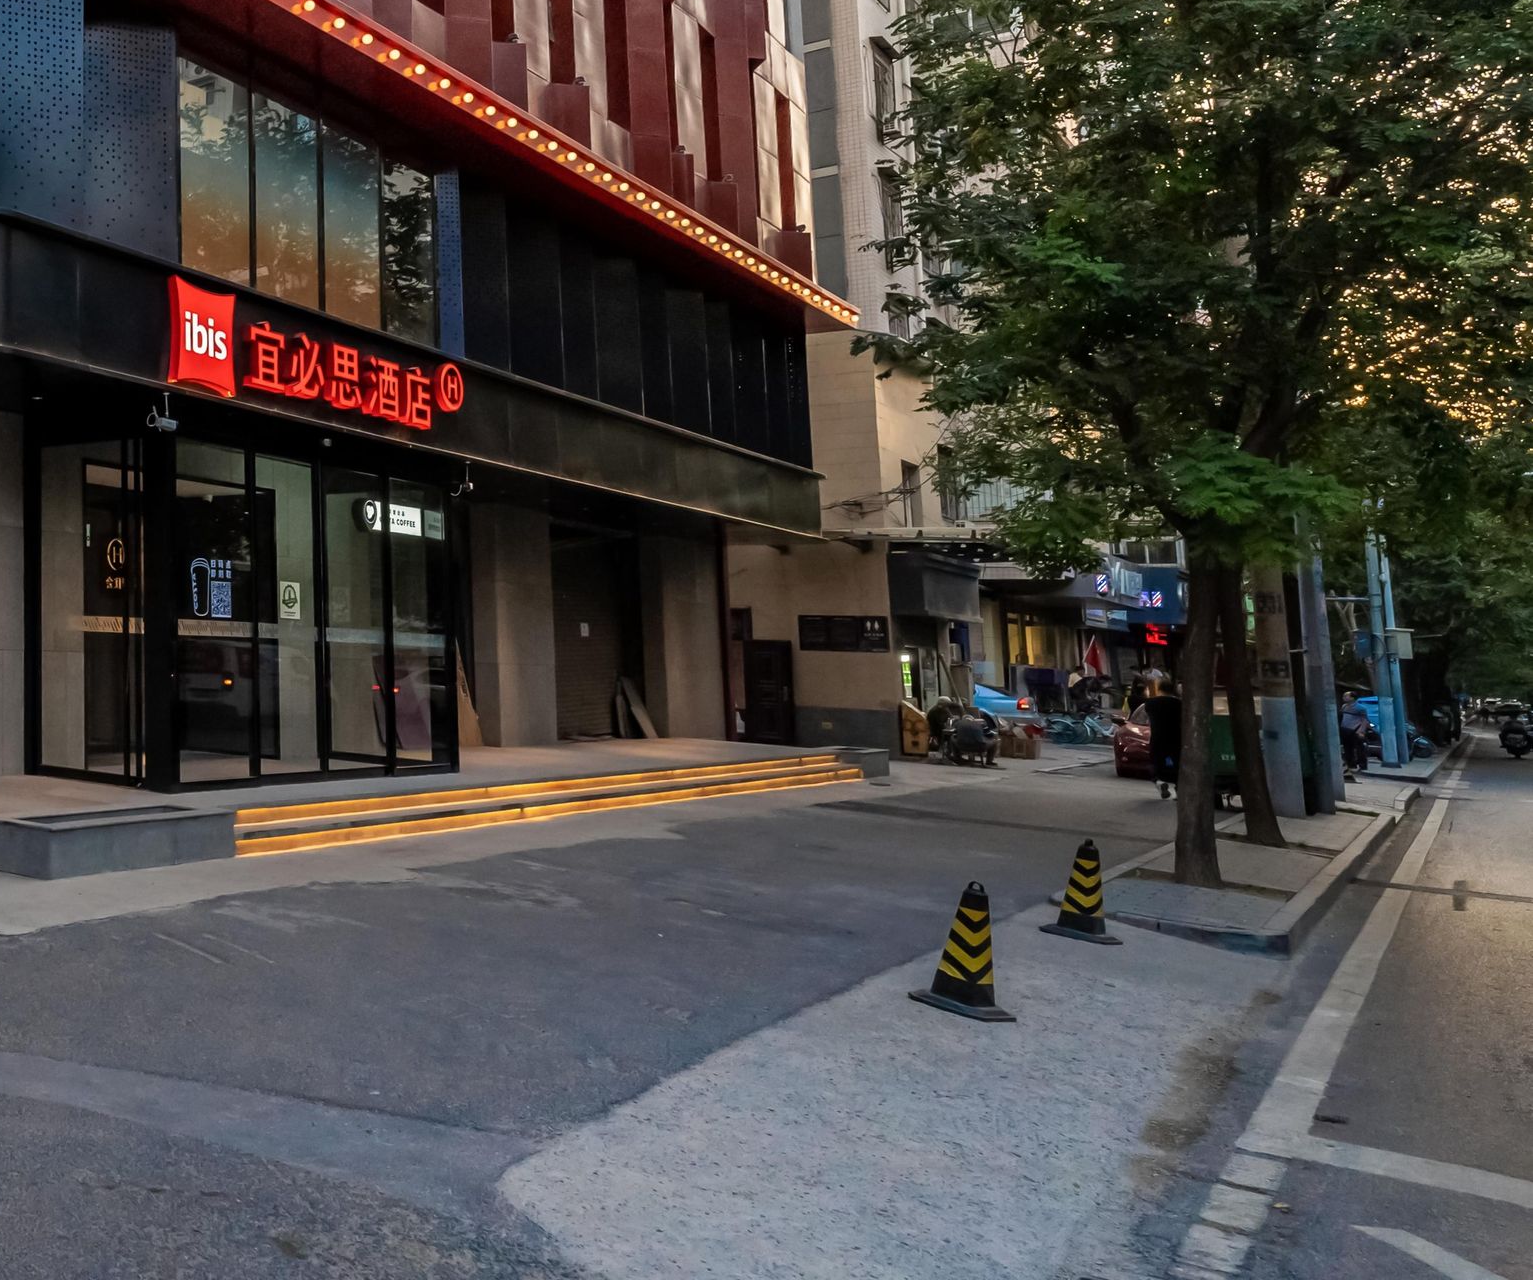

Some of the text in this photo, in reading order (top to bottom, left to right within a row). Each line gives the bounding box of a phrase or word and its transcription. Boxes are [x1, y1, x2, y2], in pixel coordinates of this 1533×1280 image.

[184, 310, 228, 361] ibis
[247, 322, 432, 430] 宜必思酒店
[396, 518, 416, 528] COFFEE
